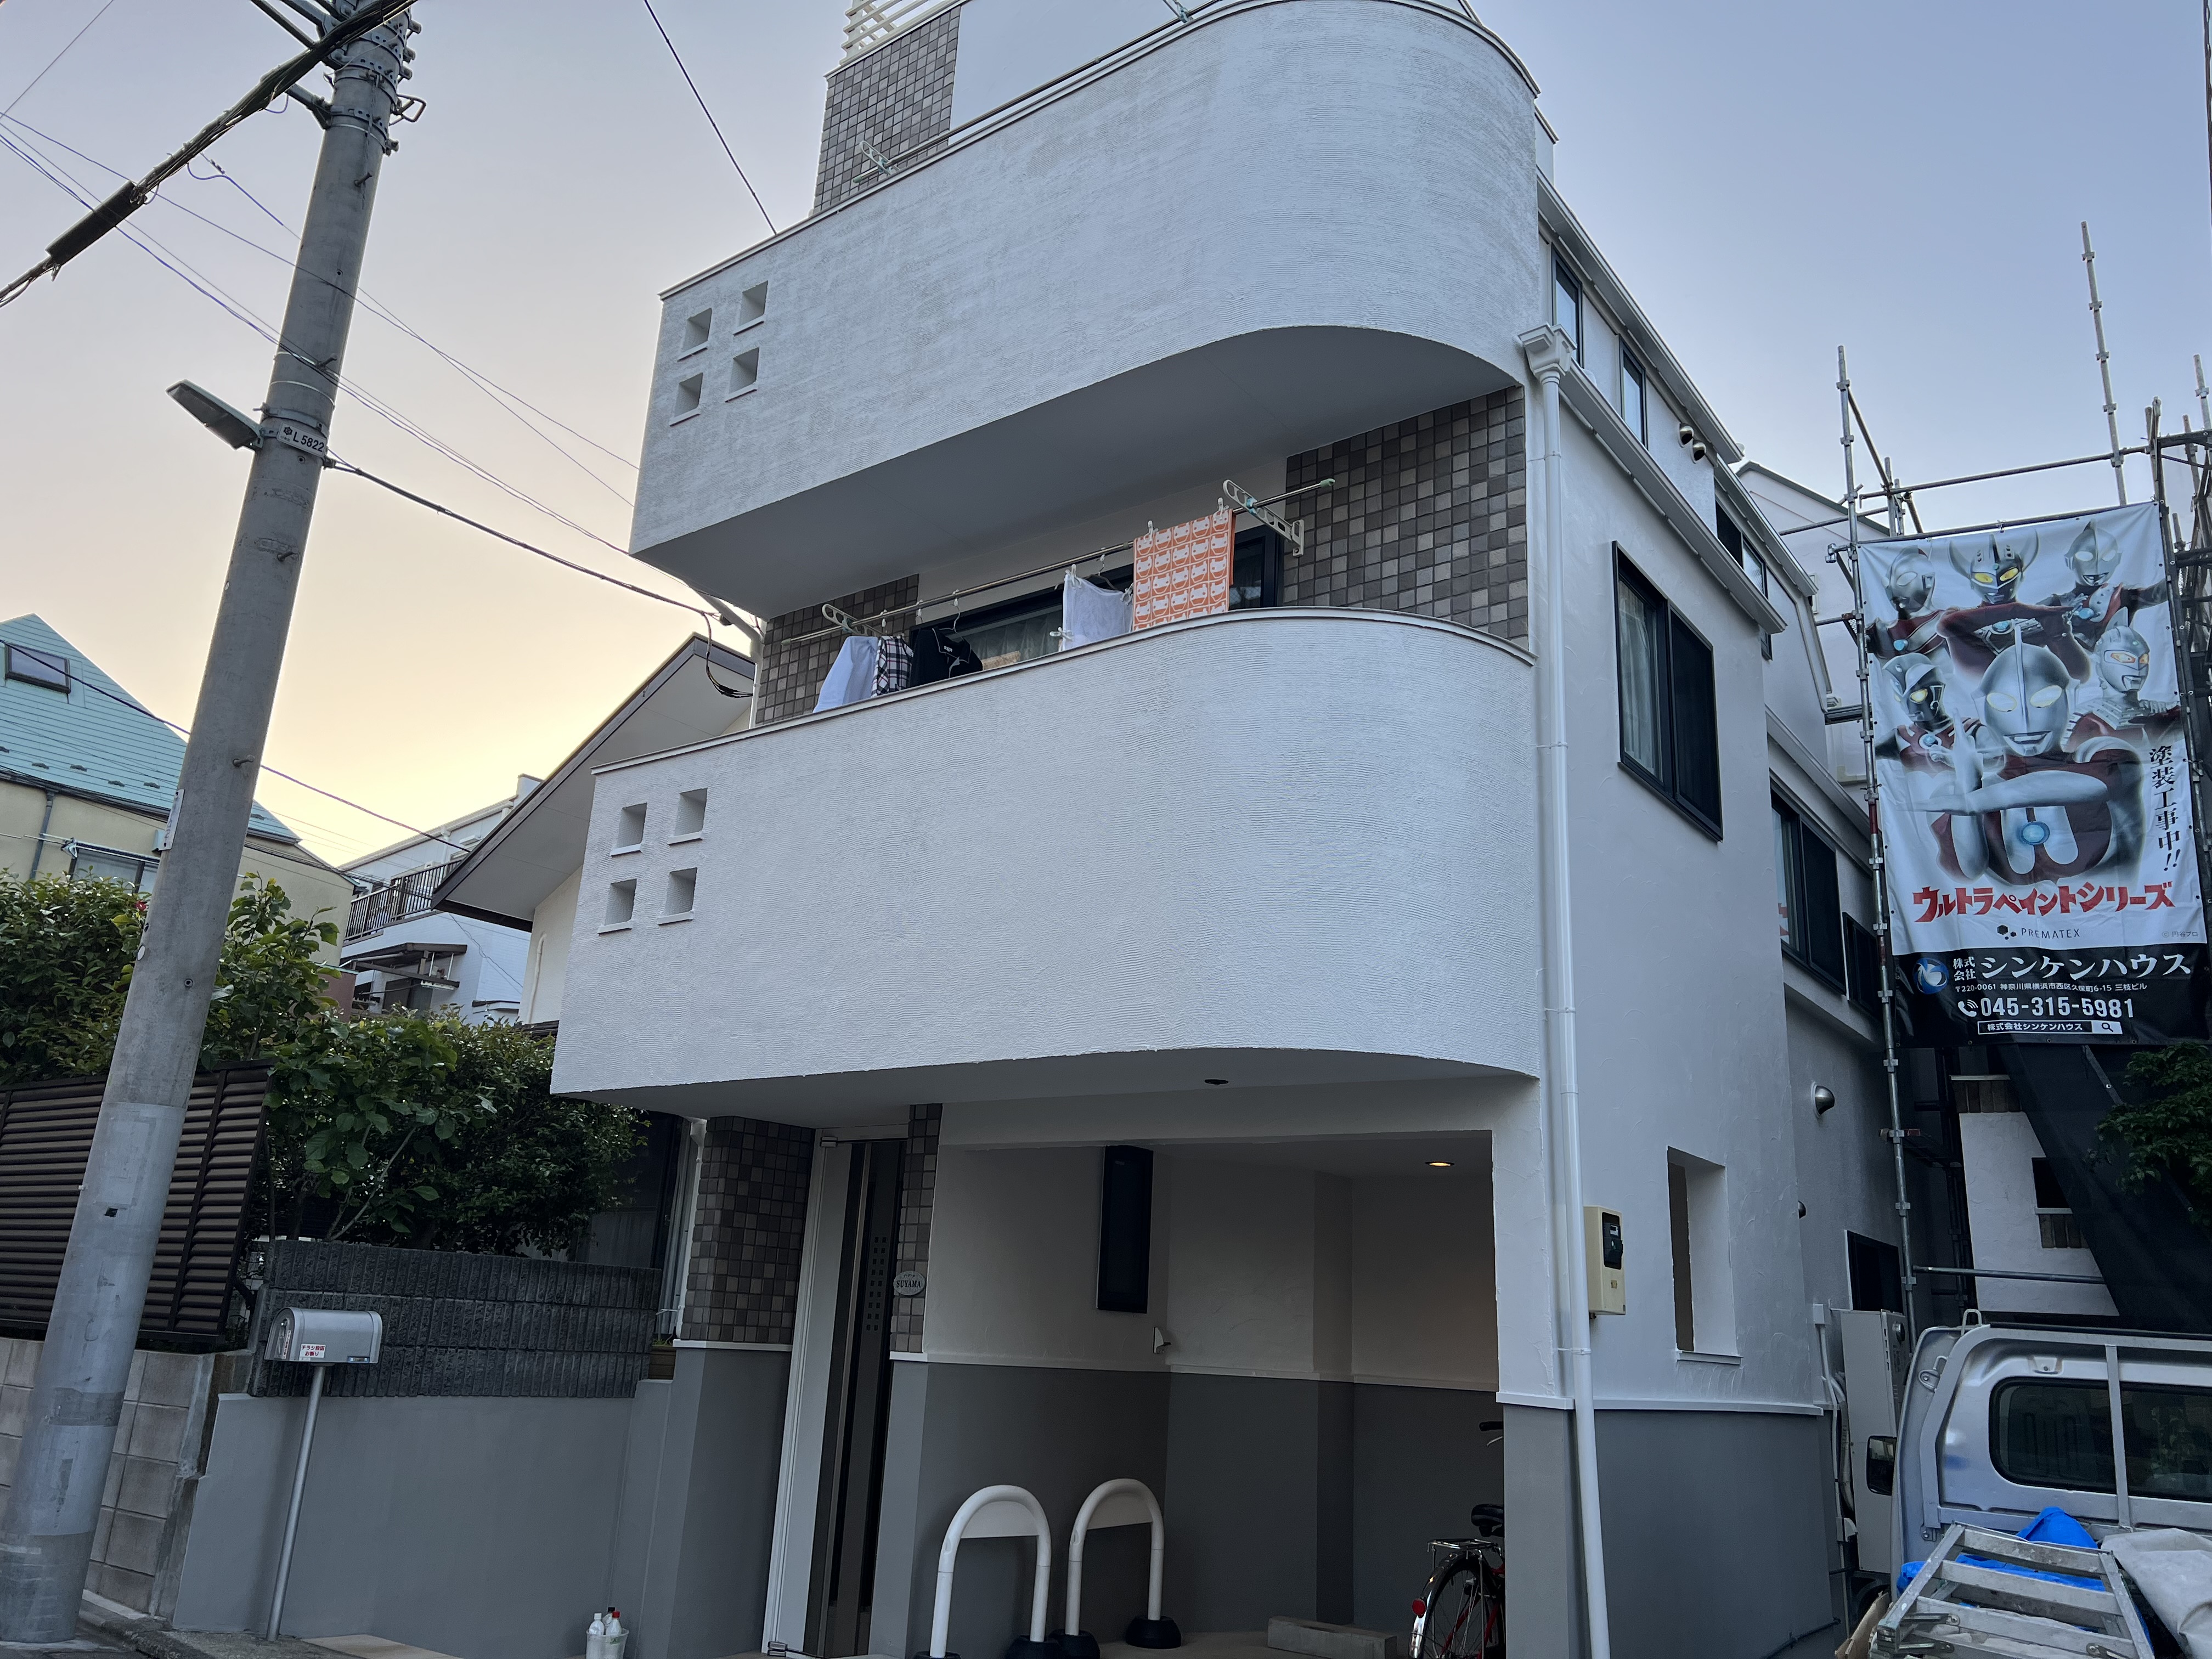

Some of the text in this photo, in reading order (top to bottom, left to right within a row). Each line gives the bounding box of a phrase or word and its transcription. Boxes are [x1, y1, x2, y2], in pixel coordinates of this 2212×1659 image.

[1912, 881, 2176, 923] ウルトラペイントシリーズ
[2021, 928, 2080, 939] PREMATEX
[1980, 953, 2191, 980] シンケンハウス
[1980, 996, 2134, 1018] 045-315-5981
[1987, 1022, 2083, 1031] 株式会社シンケンハウス
[896, 1280, 921, 1288] SUYAMA
